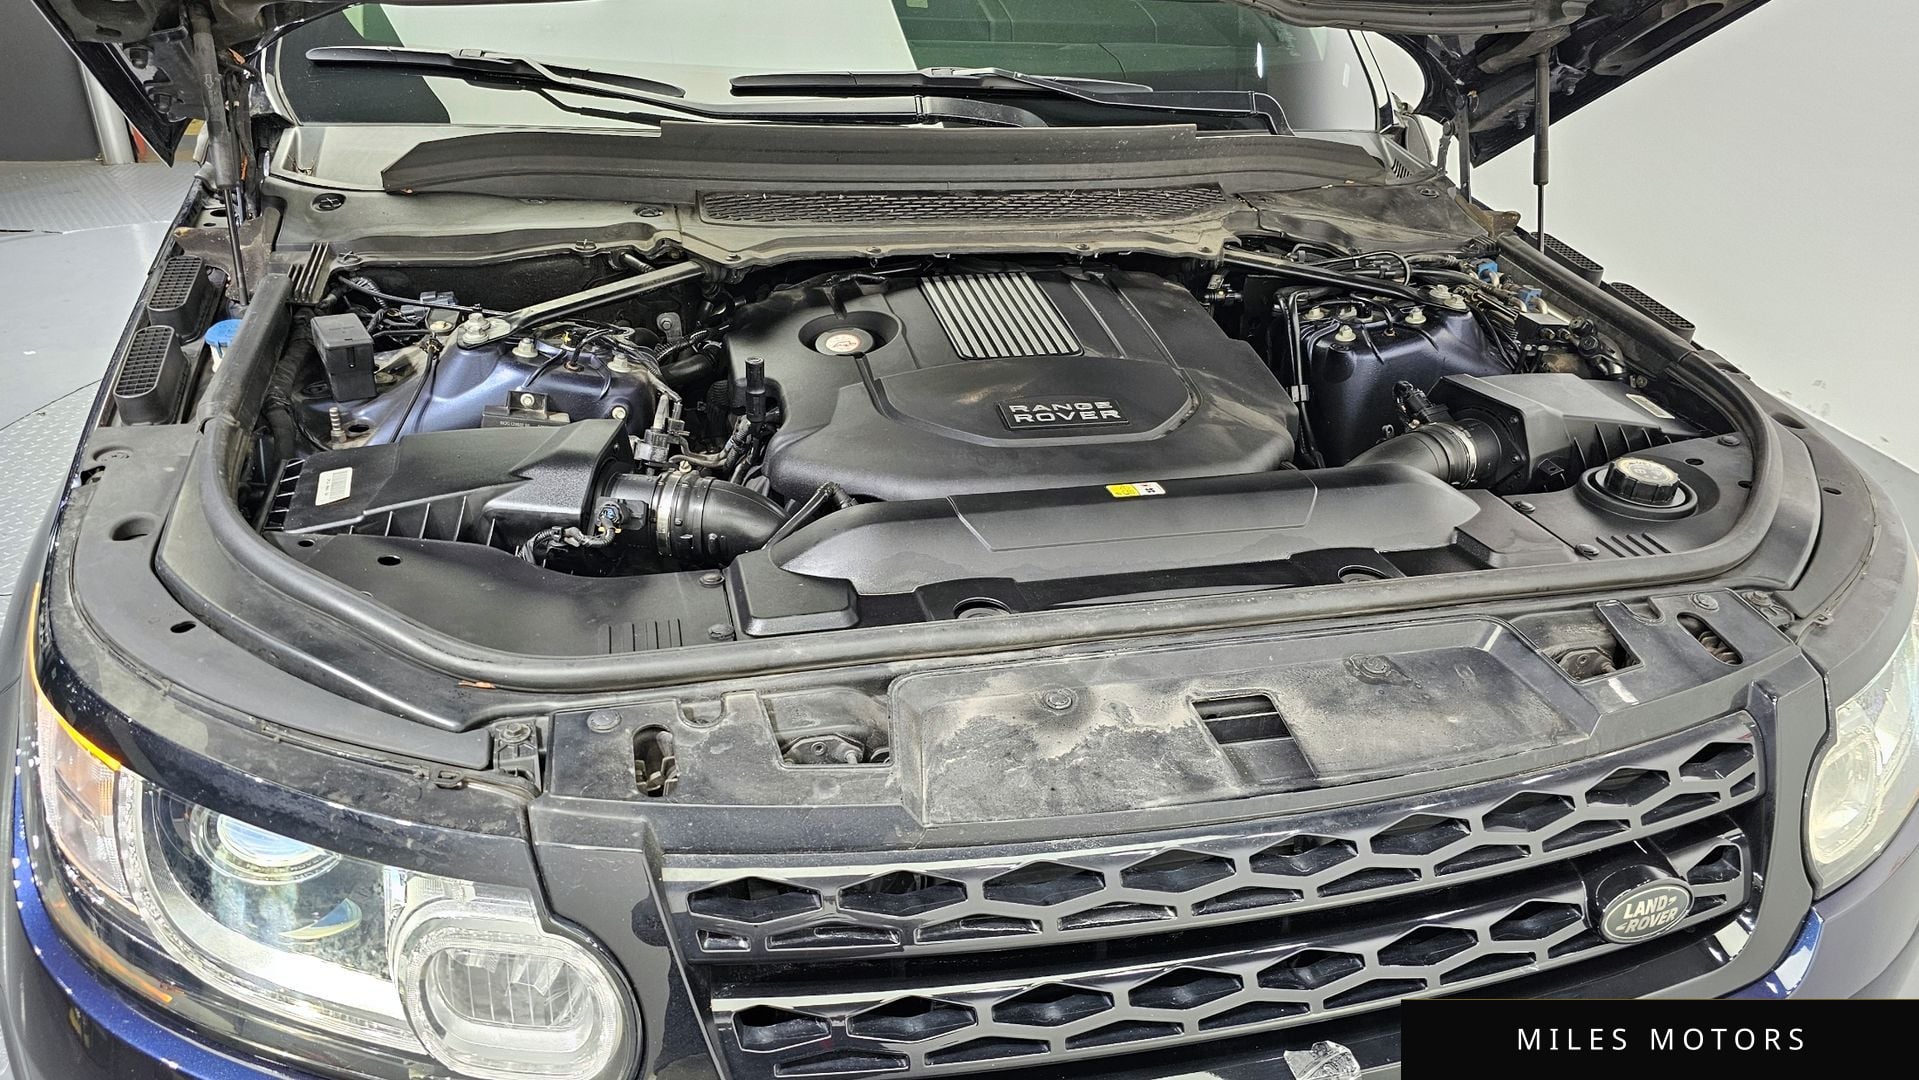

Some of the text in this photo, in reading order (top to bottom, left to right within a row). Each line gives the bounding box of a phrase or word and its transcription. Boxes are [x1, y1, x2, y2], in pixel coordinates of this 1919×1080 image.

[1008, 401, 1113, 413] RANGE
[1013, 410, 1121, 423] ROVER
[1623, 895, 1669, 919] LAND
[1624, 907, 1679, 933] ROVER
